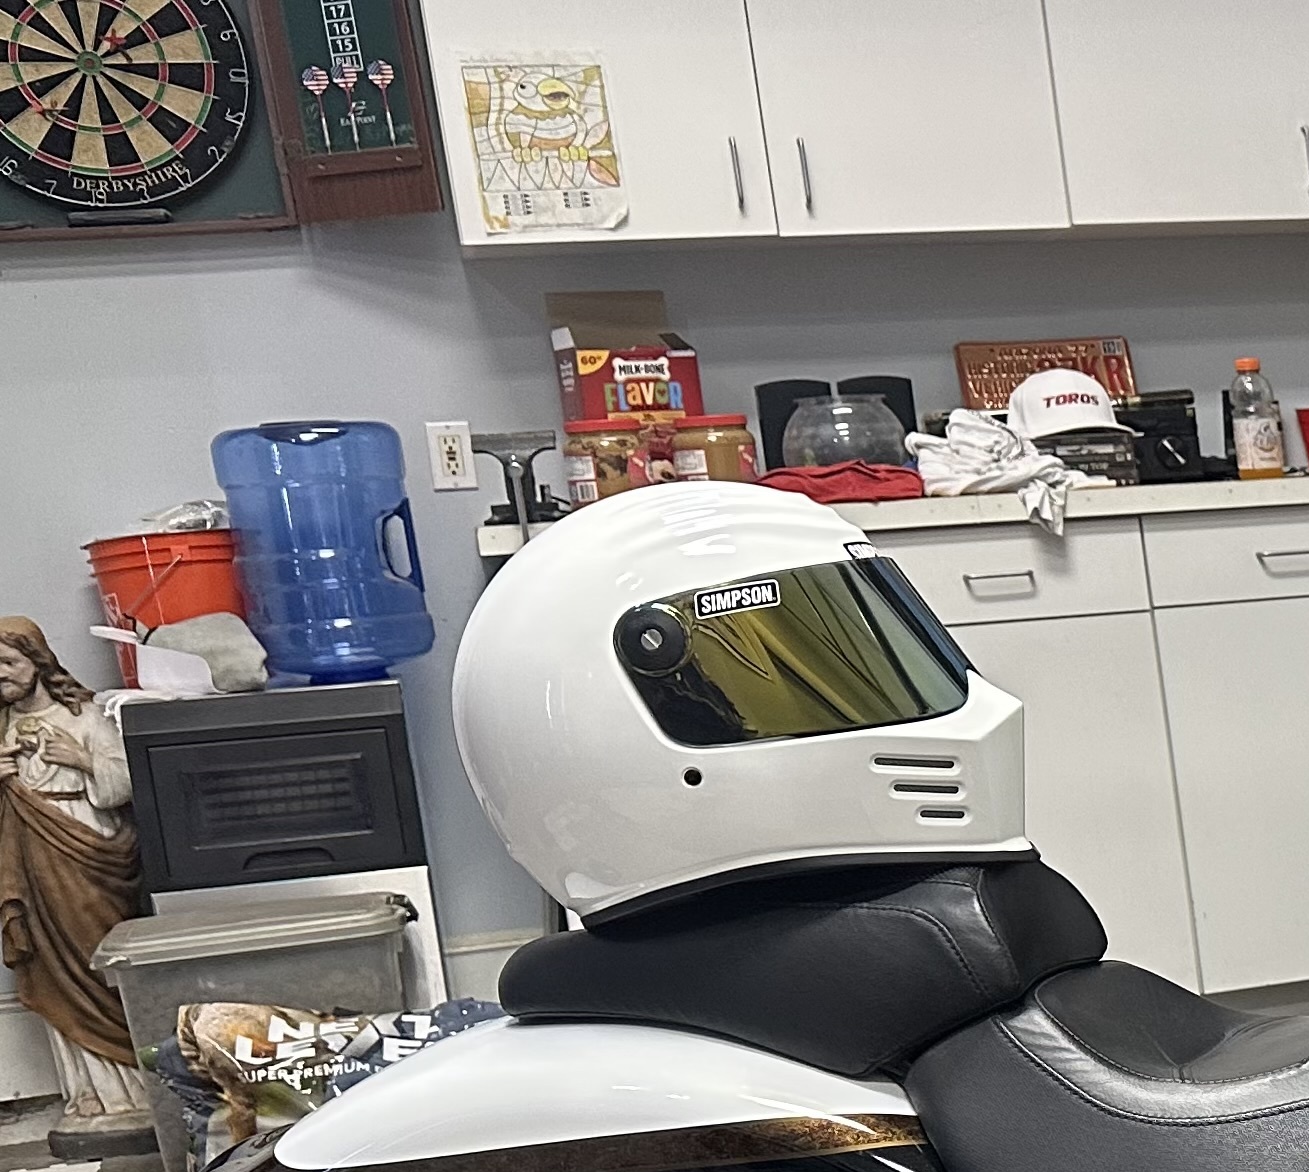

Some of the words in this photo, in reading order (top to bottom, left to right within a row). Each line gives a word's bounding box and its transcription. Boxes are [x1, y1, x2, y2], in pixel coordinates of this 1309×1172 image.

[329, 5, 346, 19] 17
[220, 29, 238, 41] 6
[333, 23, 350, 36] 16
[336, 39, 353, 52] 15
[229, 68, 248, 83] 10
[224, 108, 244, 125] 15
[207, 146, 223, 162] 2
[72, 160, 187, 193] DERBYSHIRE
[44, 179, 57, 196] 7
[136, 184, 151, 203] 3
[1043, 393, 1100, 409] TOROS
[701, 584, 774, 615] SIMPSON
[294, 1061, 370, 1080] PREMIUM
